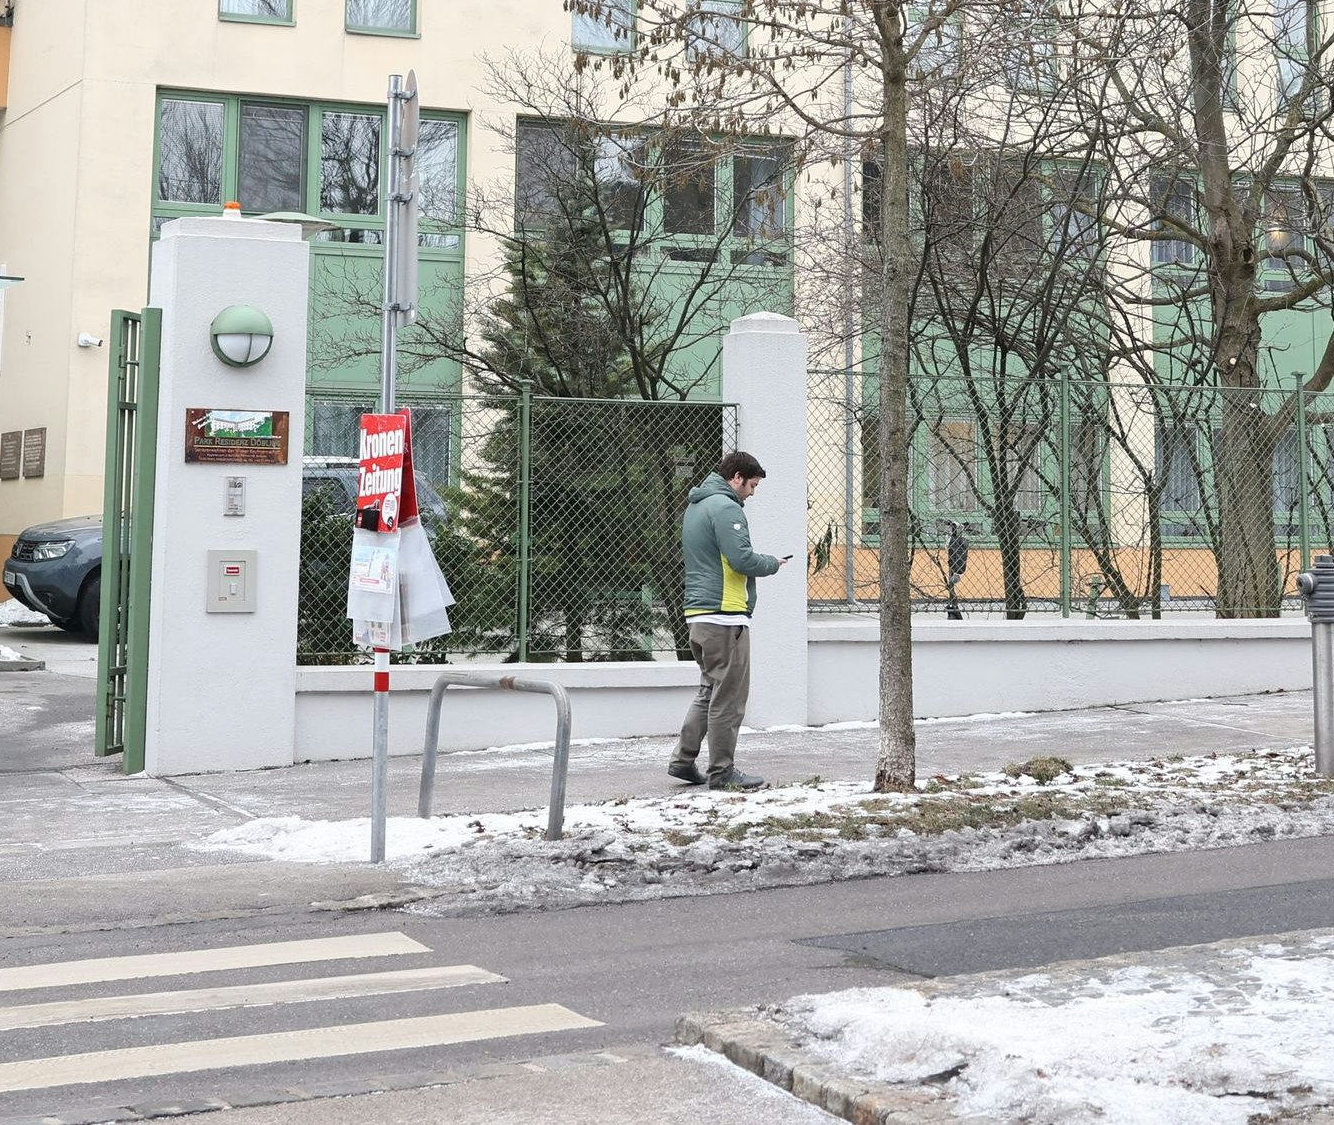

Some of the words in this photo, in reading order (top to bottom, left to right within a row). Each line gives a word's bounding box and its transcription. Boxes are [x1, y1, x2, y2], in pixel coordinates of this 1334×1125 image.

[194, 436, 213, 445] PARK
[215, 437, 248, 446] RESIDENZ
[360, 428, 404, 461] Kronen
[359, 463, 402, 497] Zeitung
